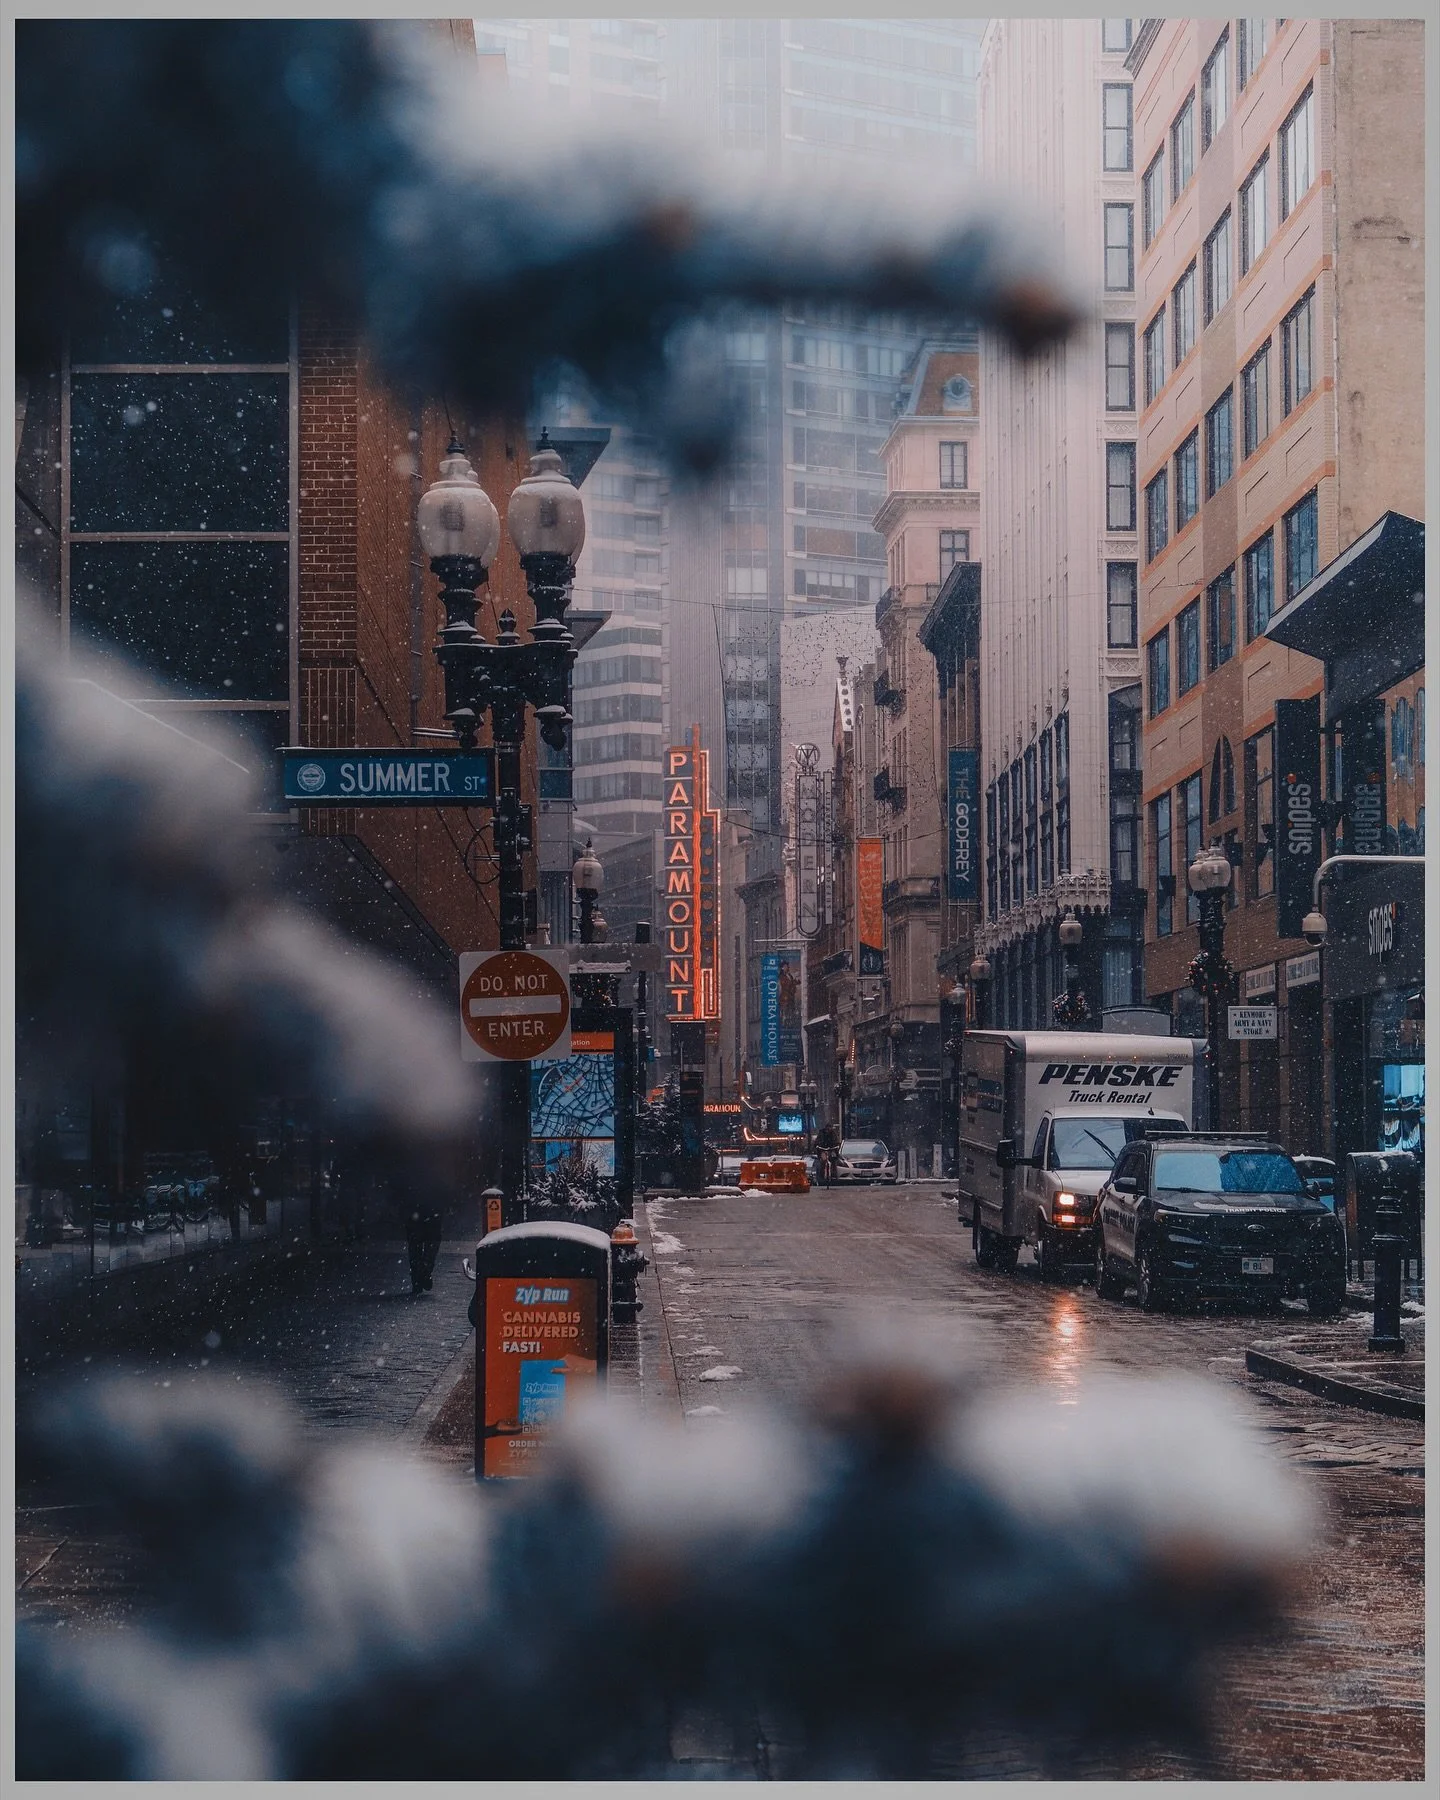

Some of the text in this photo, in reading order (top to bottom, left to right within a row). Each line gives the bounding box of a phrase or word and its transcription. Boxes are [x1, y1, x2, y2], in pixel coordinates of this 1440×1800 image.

[340, 763, 480, 792] SUMMER ST
[955, 768, 970, 882] THE GODFREY
[1287, 783, 1316, 855] snipes
[667, 752, 691, 1012] PARAMOUNT
[1368, 903, 1393, 962] snipes
[480, 974, 548, 992] DO NOT
[767, 981, 778, 1019] OPERA
[1240, 1011, 1266, 1019] KENMORE
[488, 1020, 545, 1037] ENTER
[767, 1022, 778, 1061] HOUSE
[1038, 1064, 1183, 1087] PENSKE
[1068, 1090, 1153, 1104] Truck Rental
[515, 1285, 570, 1304] Zyp Run
[502, 1326, 579, 1338] DELIVERED
[502, 1341, 541, 1353] FAST!
[508, 1440, 537, 1448] ORDER
